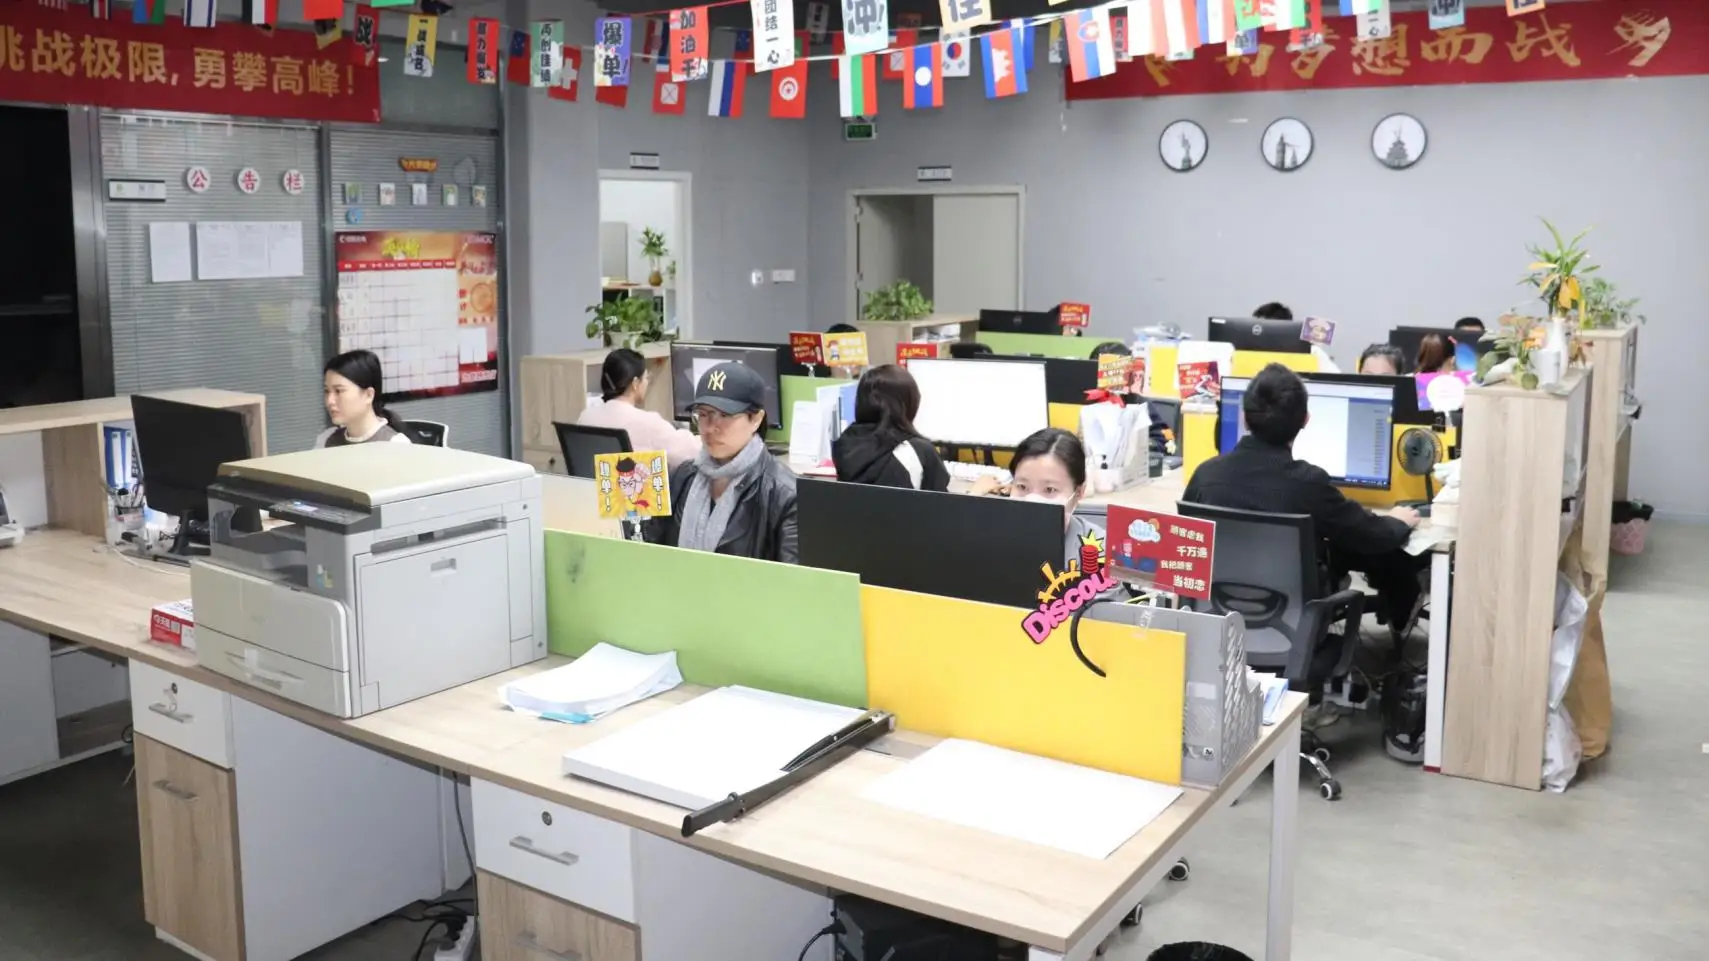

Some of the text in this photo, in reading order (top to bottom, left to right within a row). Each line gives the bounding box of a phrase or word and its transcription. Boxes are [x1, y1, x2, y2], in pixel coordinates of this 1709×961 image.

[680, 10, 697, 81] 加油干
[764, 0, 781, 65] 团结一心
[0, 24, 354, 98] 挑战极限，勇攀高峰！
[190, 169, 304, 192] 公告栏
[1176, 545, 1208, 559] 千万遍
[1172, 574, 1206, 592] 当初恋
